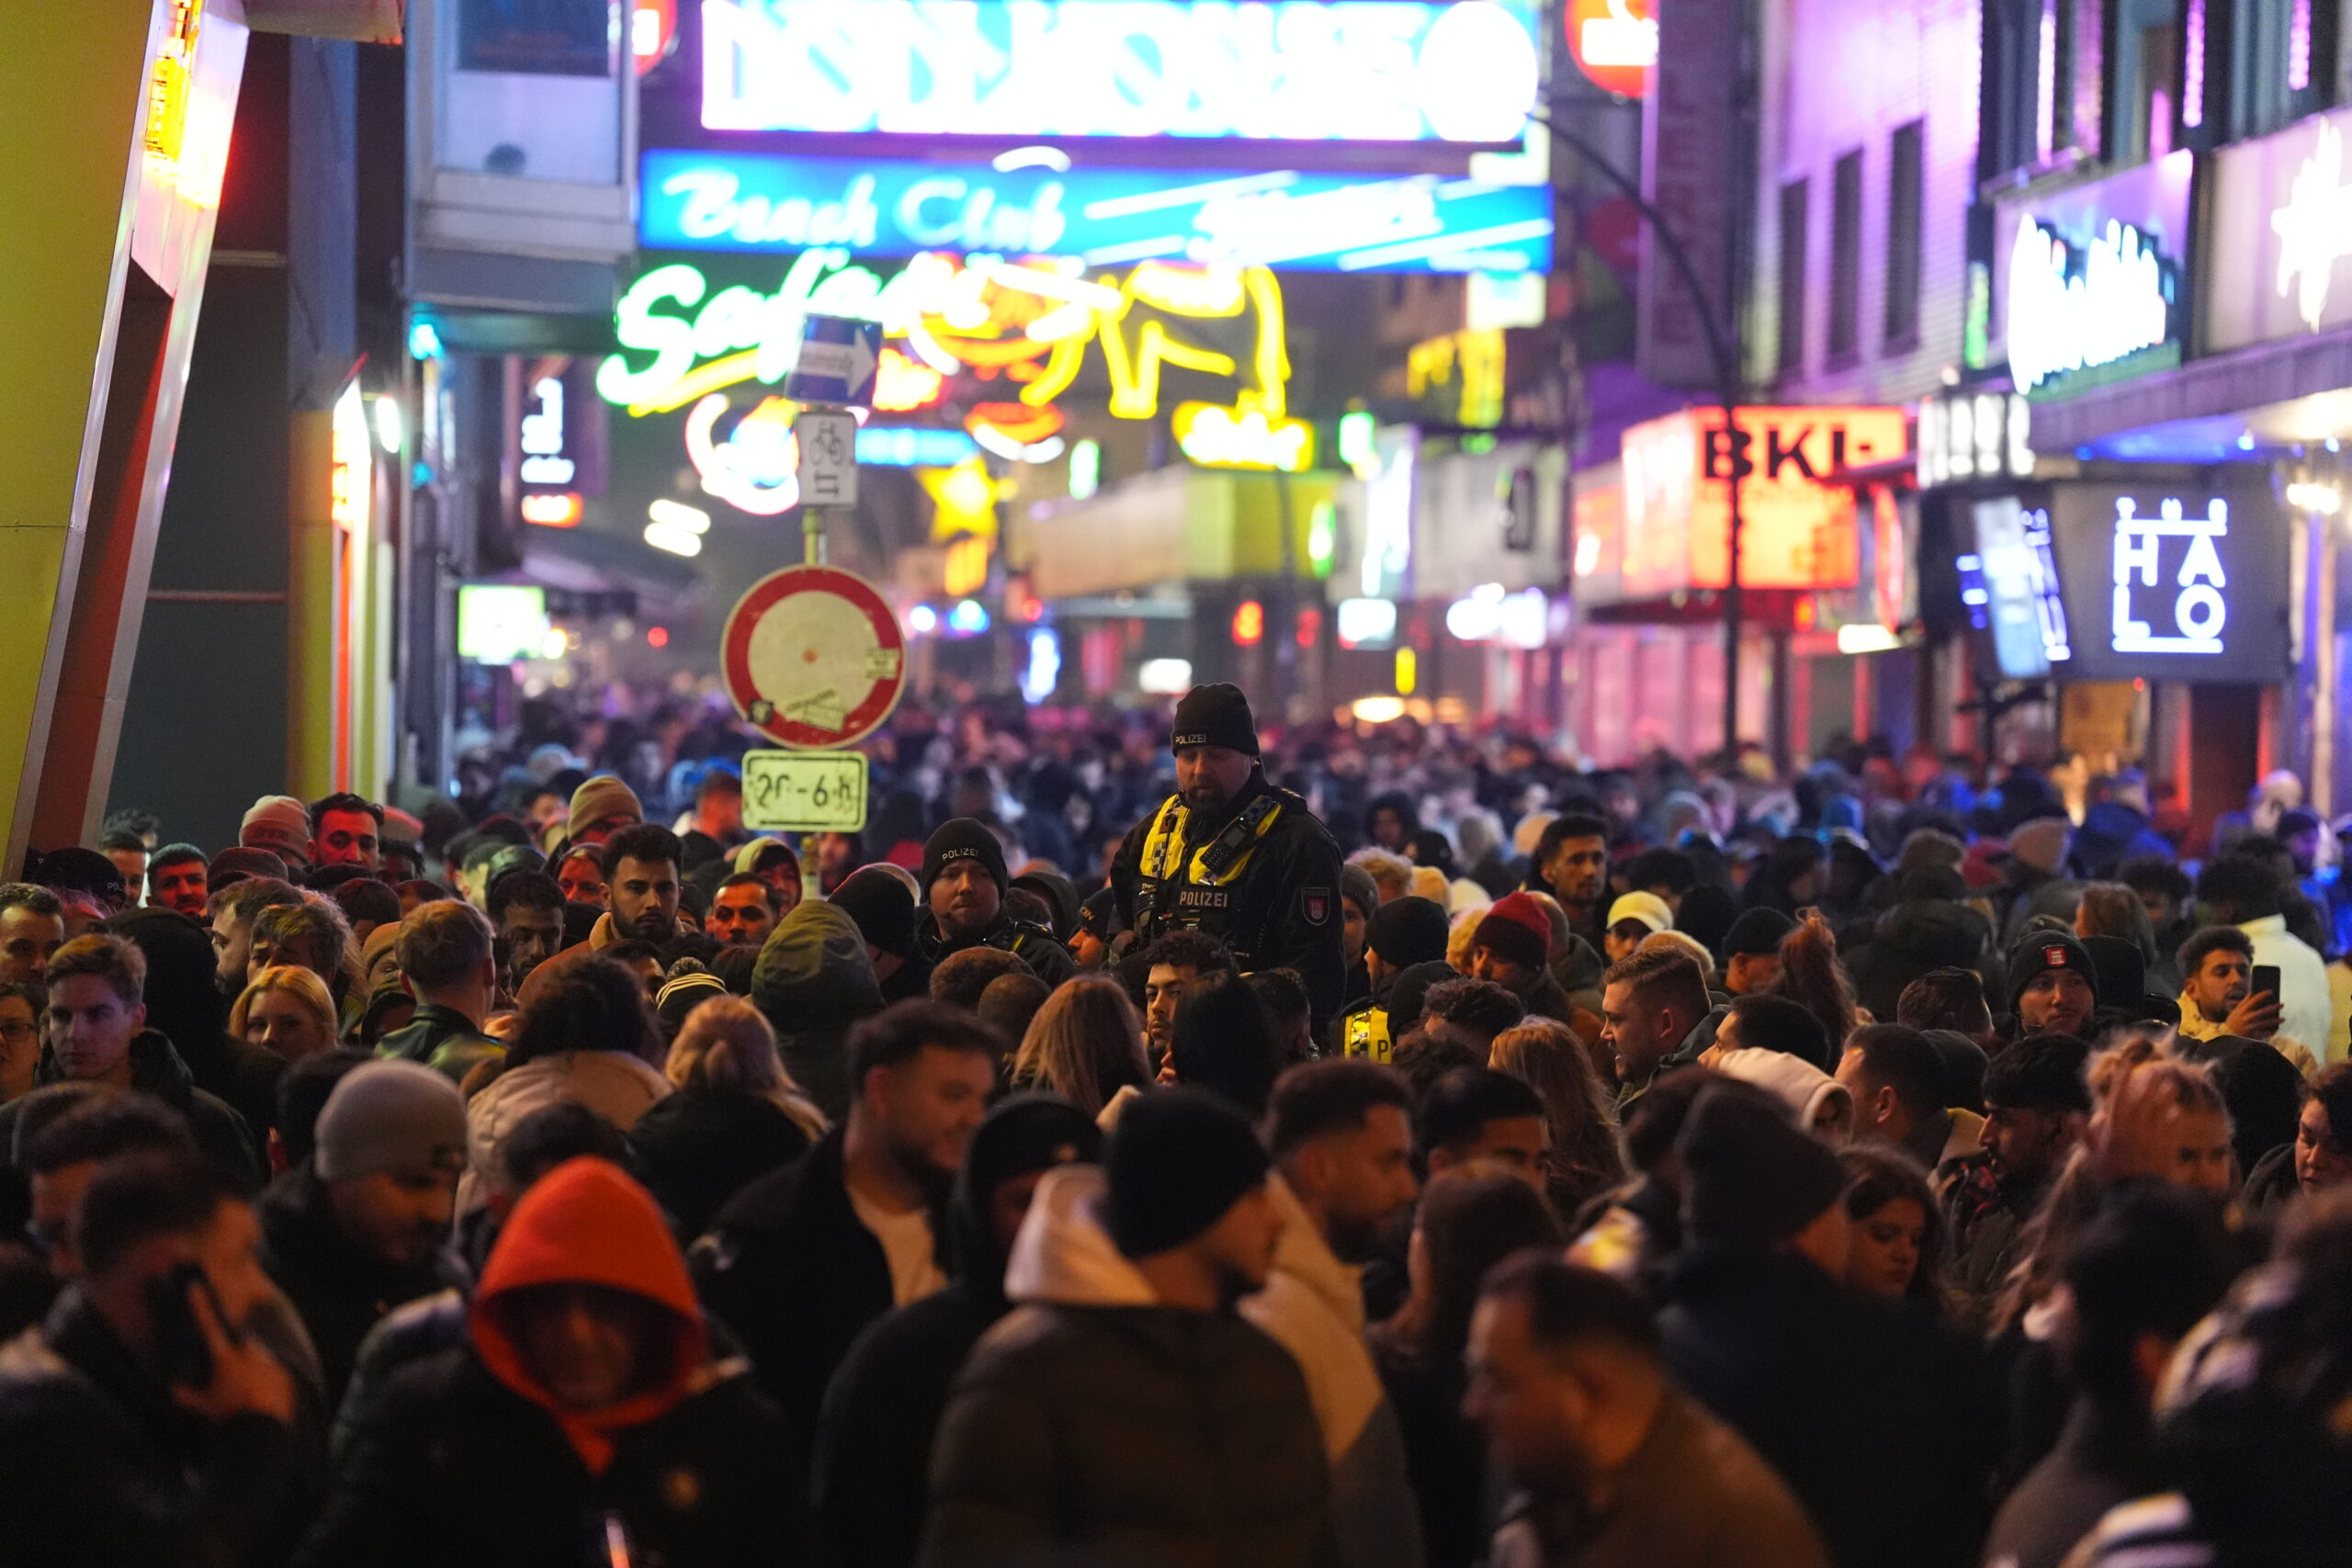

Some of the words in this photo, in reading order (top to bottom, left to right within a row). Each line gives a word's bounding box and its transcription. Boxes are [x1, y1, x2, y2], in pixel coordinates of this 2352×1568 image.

[892, 175, 1066, 252] Club
[1175, 734, 1206, 744] POLIZEI
[942, 847, 978, 861] POLIZEI
[1179, 891, 1228, 908] POLIZEI
